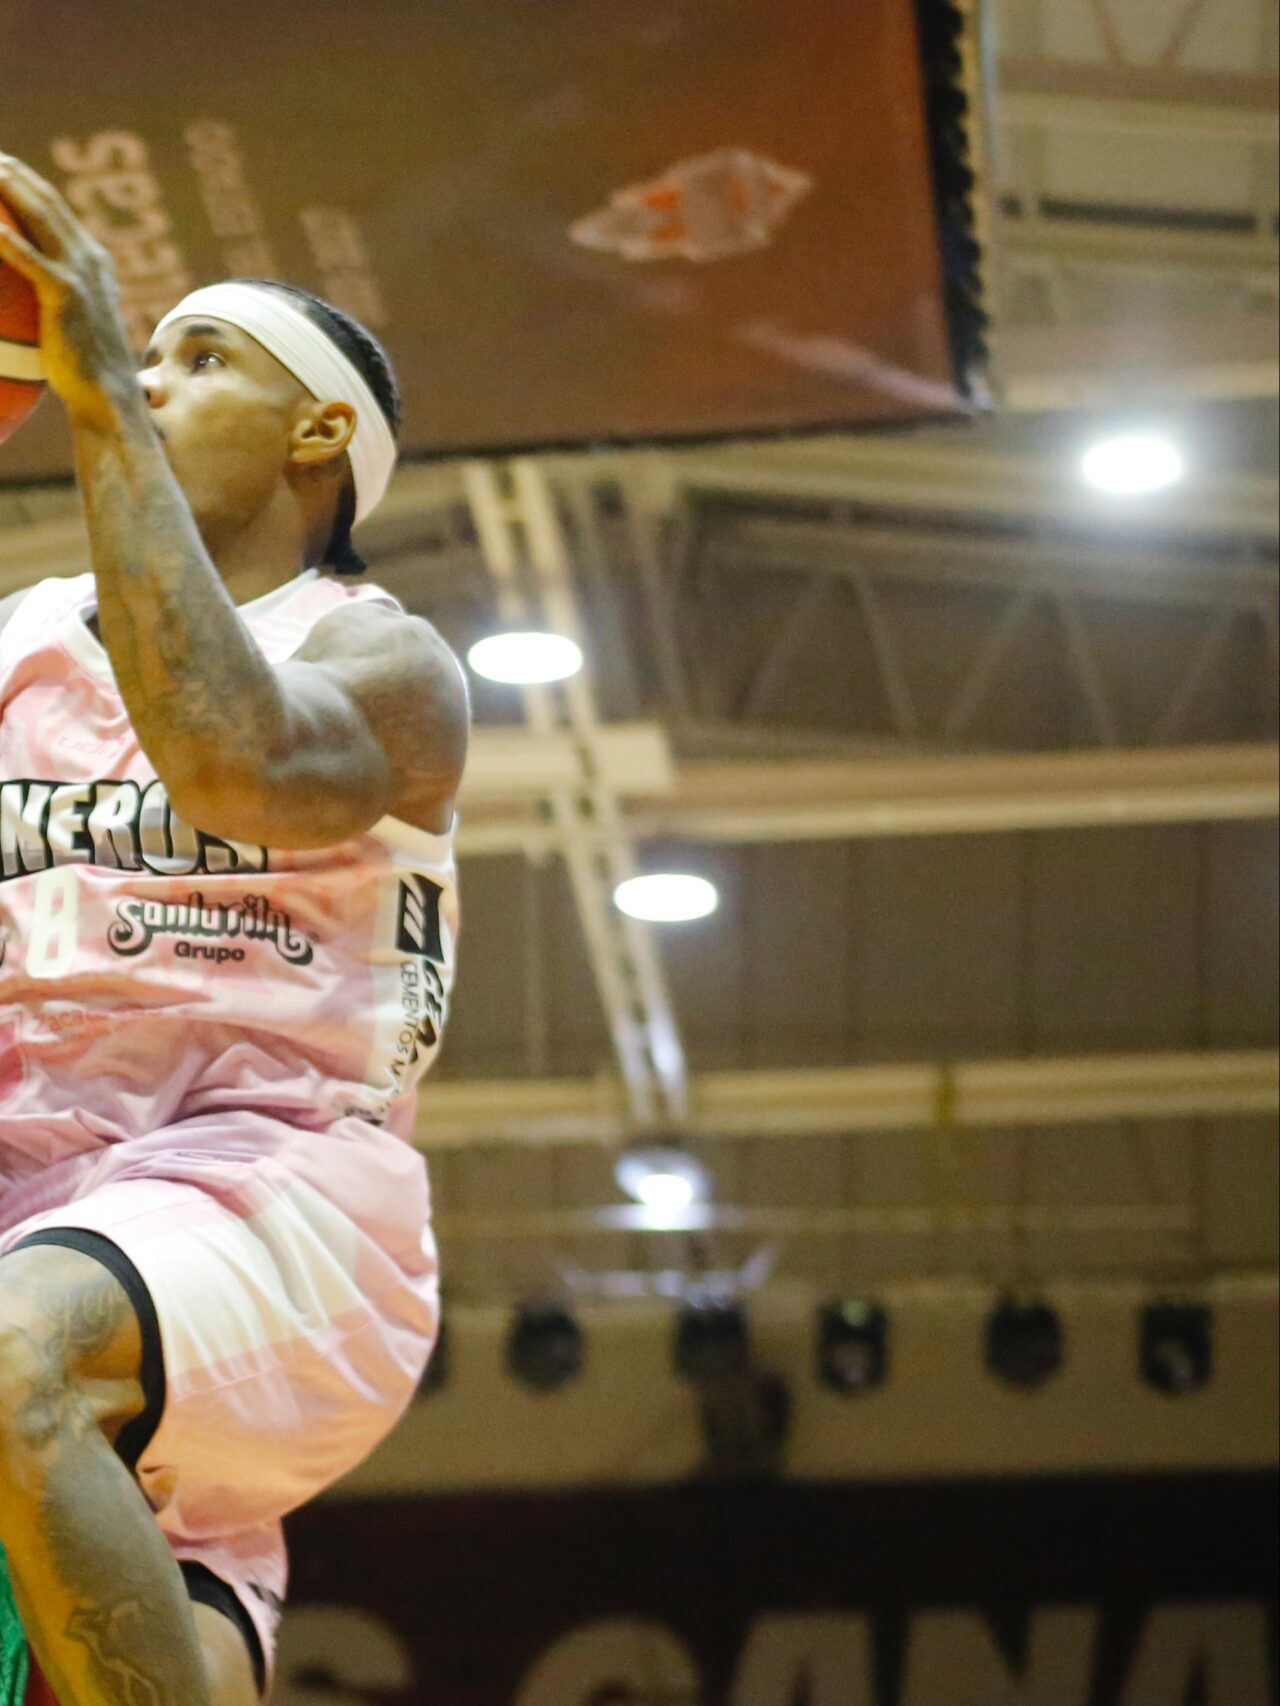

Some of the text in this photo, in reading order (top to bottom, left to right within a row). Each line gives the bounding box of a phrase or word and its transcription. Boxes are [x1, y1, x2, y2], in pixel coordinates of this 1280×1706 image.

[25, 864, 78, 979] 8
[173, 941, 246, 964] Grupo
[396, 961, 419, 1054] CEMENTOS
